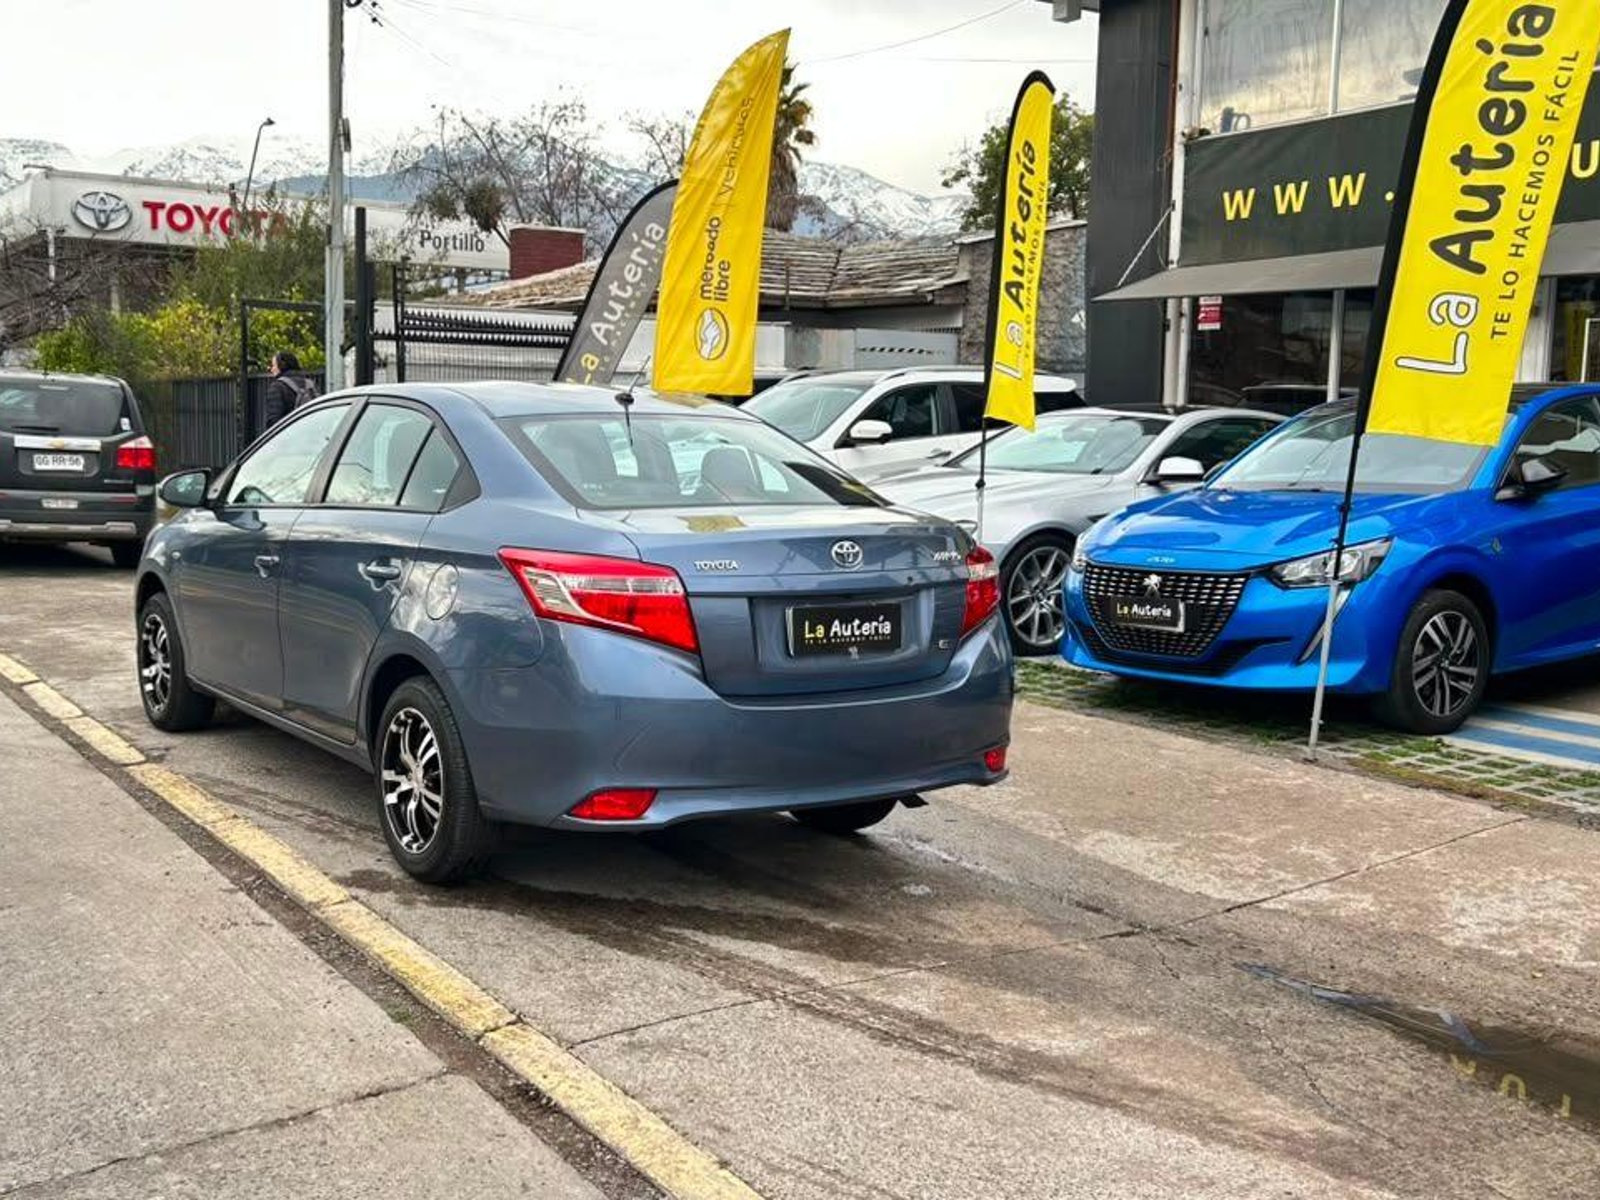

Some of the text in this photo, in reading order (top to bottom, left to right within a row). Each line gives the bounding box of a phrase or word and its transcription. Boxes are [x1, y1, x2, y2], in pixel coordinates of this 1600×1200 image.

[1394, 4, 1557, 376] La Autería
[1490, 50, 1580, 340] TE LO HACEMOS FÁCIL
[420, 230, 485, 253] Portillo
[1004, 140, 1035, 313] Autería
[590, 222, 666, 347] Autería
[713, 259, 731, 302] libre
[694, 560, 739, 571] TOYOTA
[804, 614, 892, 639] La Autería
[1116, 602, 1129, 615] La
